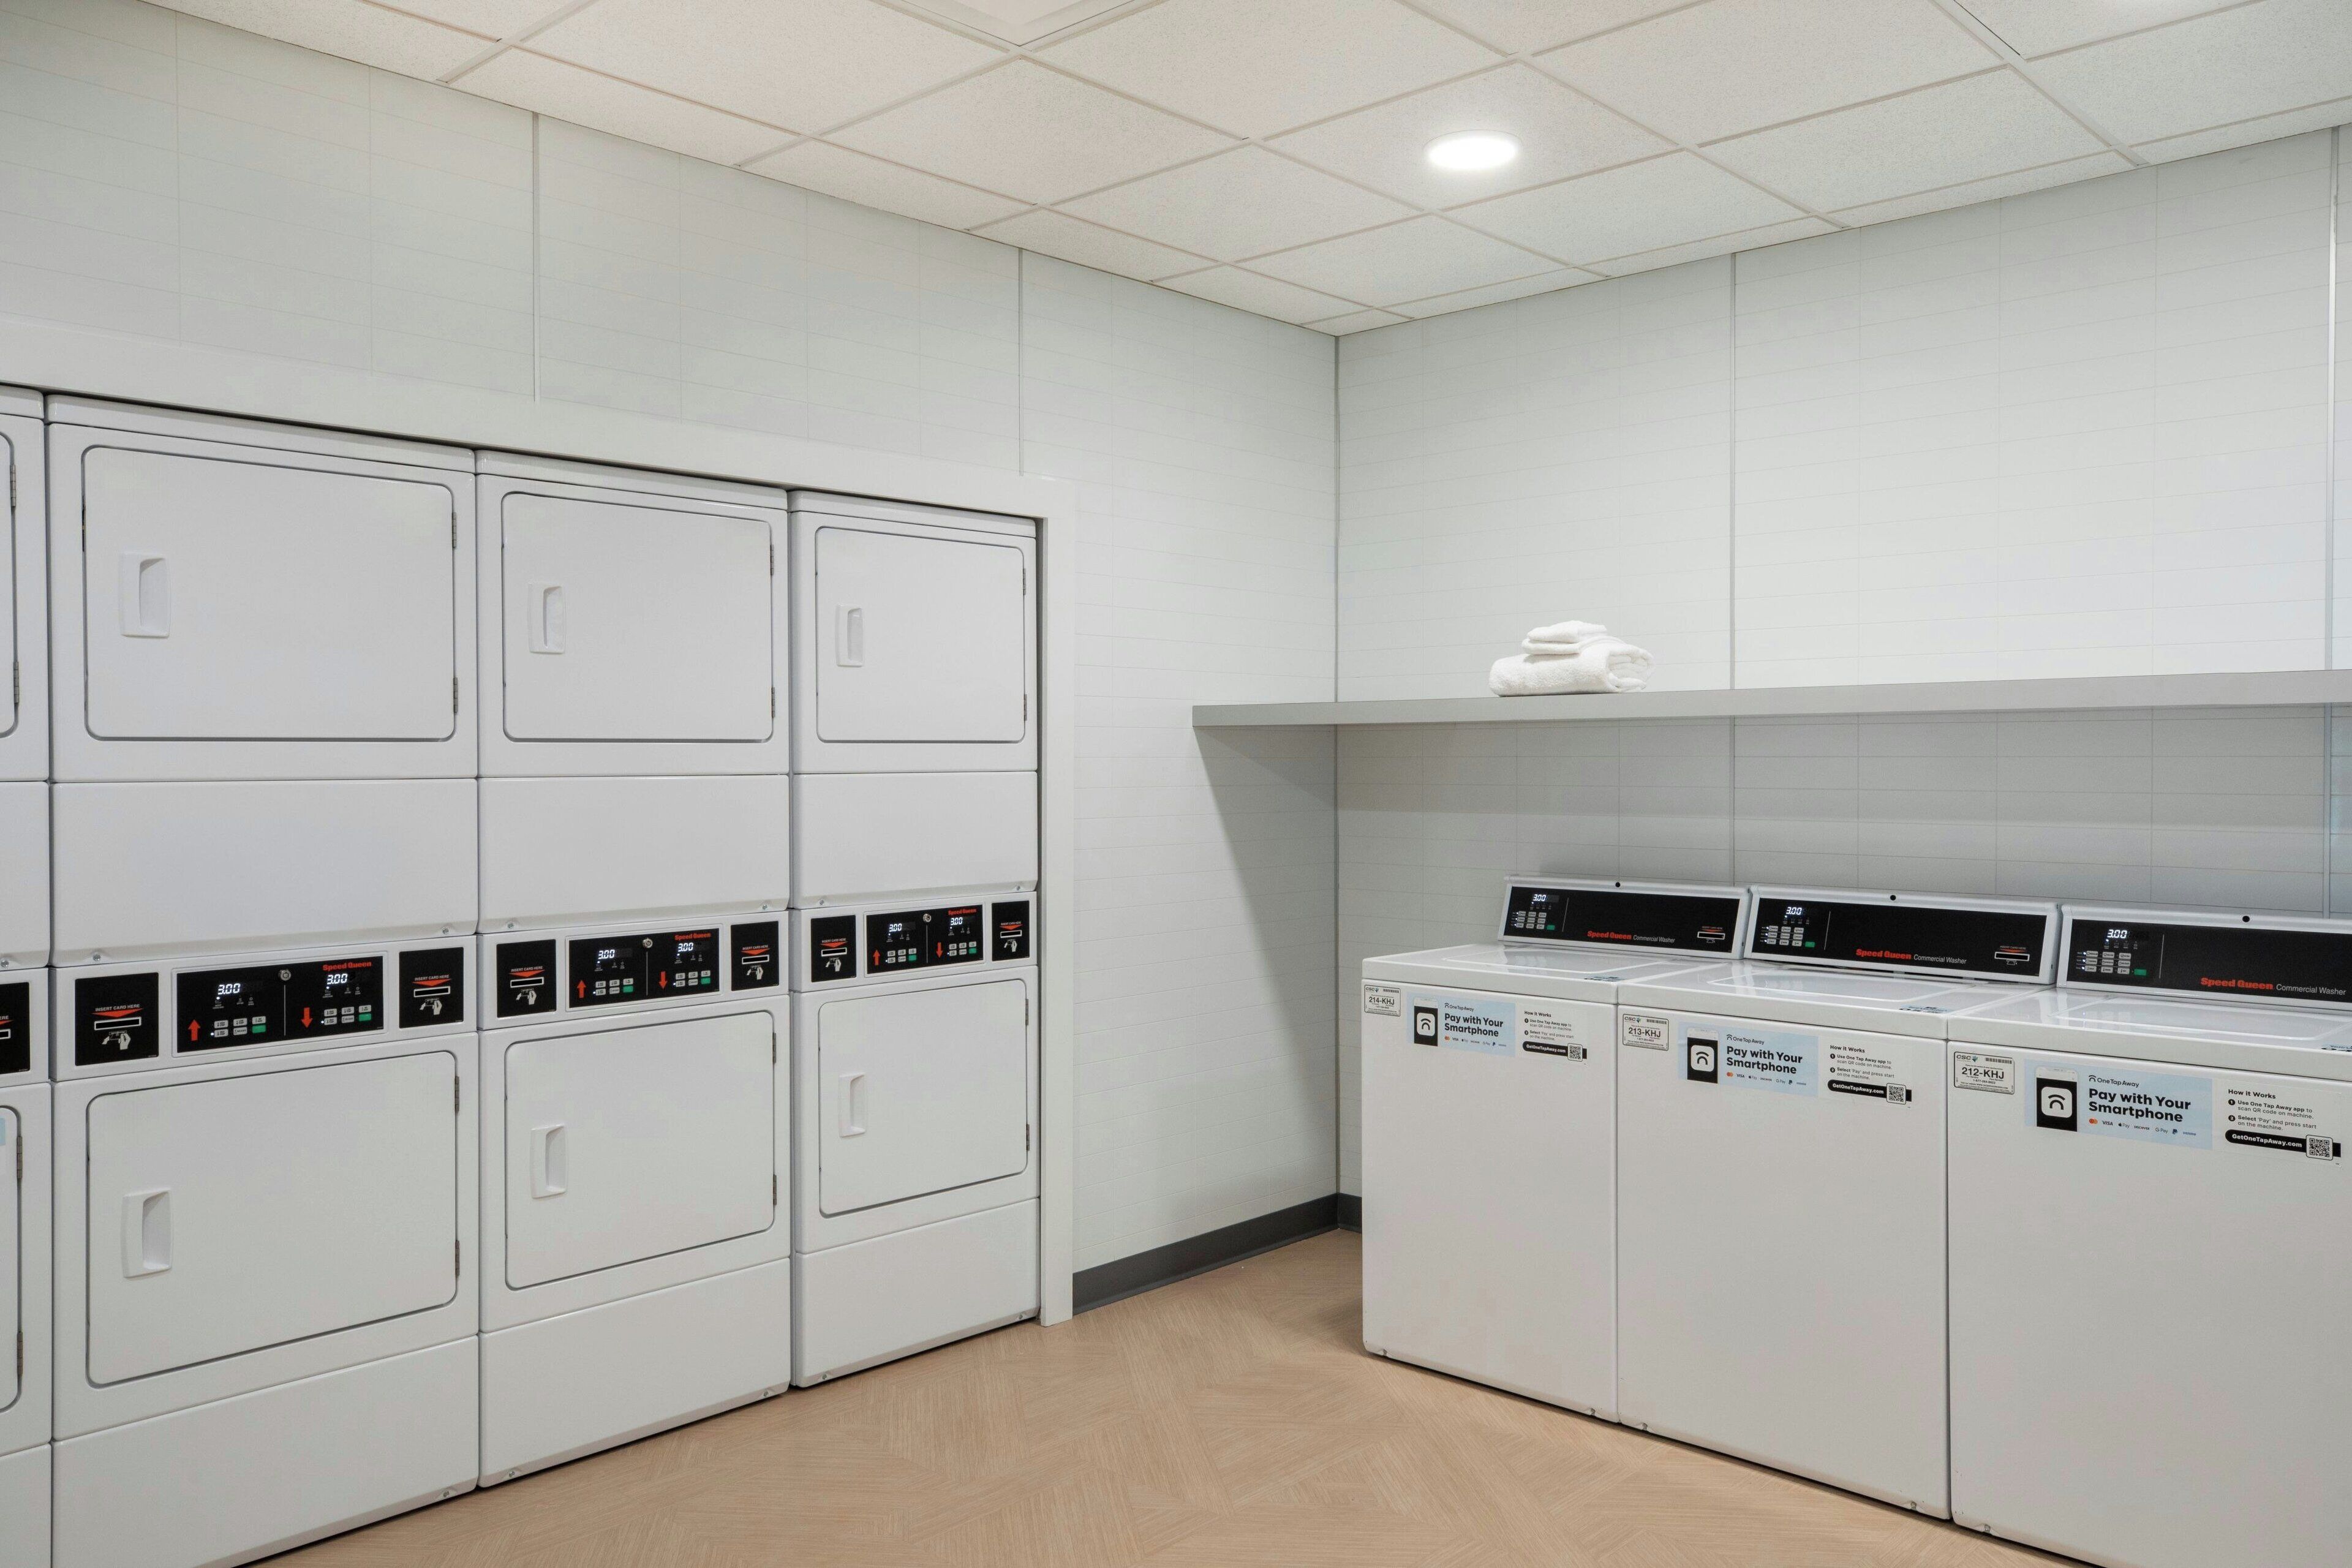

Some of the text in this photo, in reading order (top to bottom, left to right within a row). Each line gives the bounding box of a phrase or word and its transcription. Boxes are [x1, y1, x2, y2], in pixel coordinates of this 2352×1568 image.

[1785, 907, 1802, 915] 3.00
[951, 917, 963, 925] 3.00
[889, 923, 902, 932] 3.00
[2107, 929, 2128, 938] 3.00
[678, 942, 693, 952] 3.00
[598, 949, 615, 959] 3.00
[1856, 949, 1883, 957] Speed
[1884, 951, 1911, 959] Queen
[1913, 954, 1945, 962] Commercial
[327, 973, 348, 984] 3.00
[217, 983, 241, 995] 3.00
[2200, 978, 2236, 987] Speed
[2237, 980, 2273, 990] Queen
[2276, 984, 2317, 993] Commercial
[1445, 1013, 1504, 1027] Pay with Your
[1444, 1023, 1499, 1037] Smartphone
[1628, 1027, 1660, 1038] 213-KHJ
[1727, 1046, 1803, 1063] Pay with Your
[1727, 1057, 1796, 1074] Smartphone
[1962, 1067, 2004, 1079] 212-KHJ
[1833, 1084, 1884, 1094] GetOneTapAway.com
[2089, 1088, 2191, 1109] Pay with Your
[2089, 1101, 2183, 1122] Smartphone
[2232, 1134, 2302, 1148] GetOneTapAway.com
